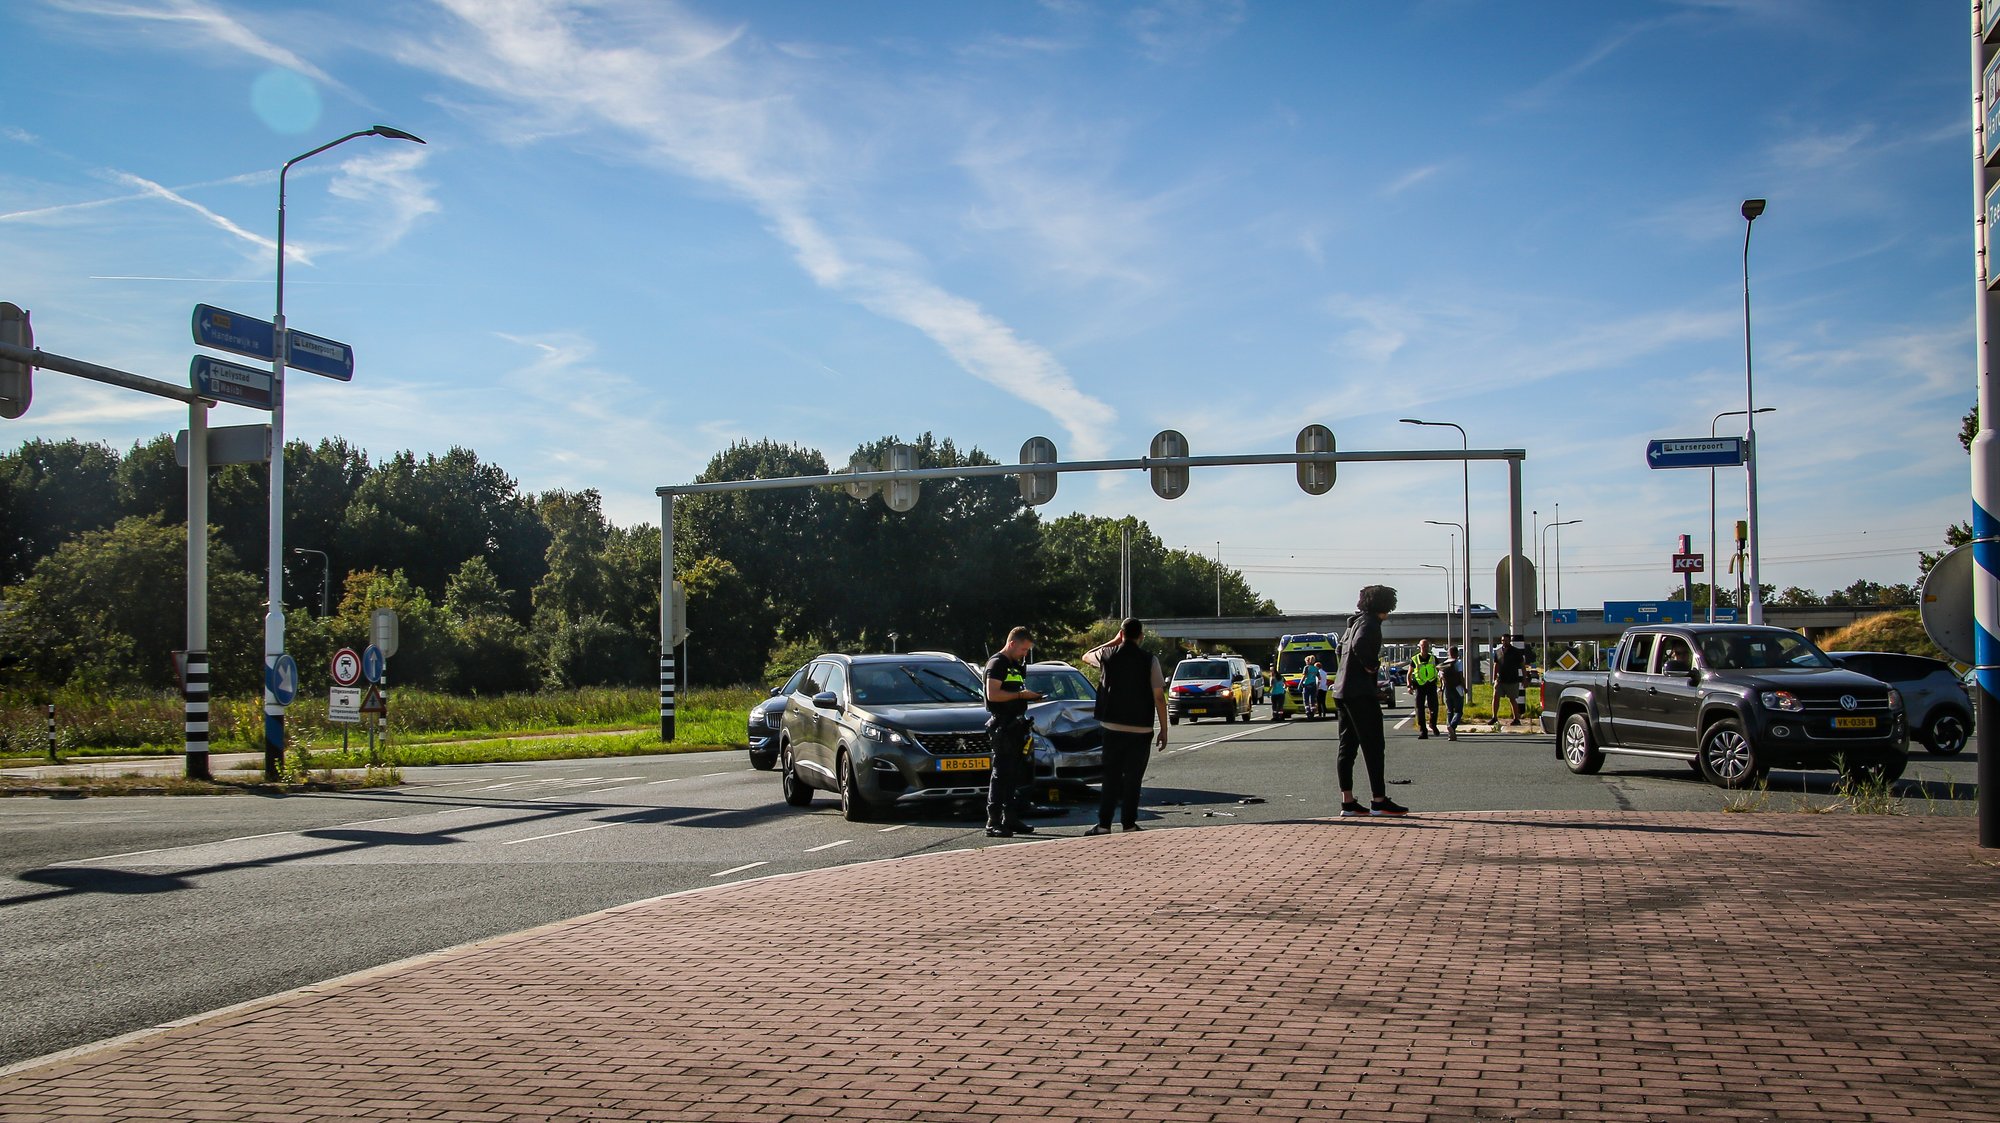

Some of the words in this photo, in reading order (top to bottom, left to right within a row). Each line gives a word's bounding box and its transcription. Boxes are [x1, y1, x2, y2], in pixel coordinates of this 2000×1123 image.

[301, 338, 335, 356] Larserpoort
[220, 366, 250, 383] Lelystad
[1674, 442, 1724, 452] Larserpoort
[1674, 558, 1703, 569] KFC
[1836, 718, 1874, 727] VK-038-B
[945, 758, 987, 770] RB-651-L
